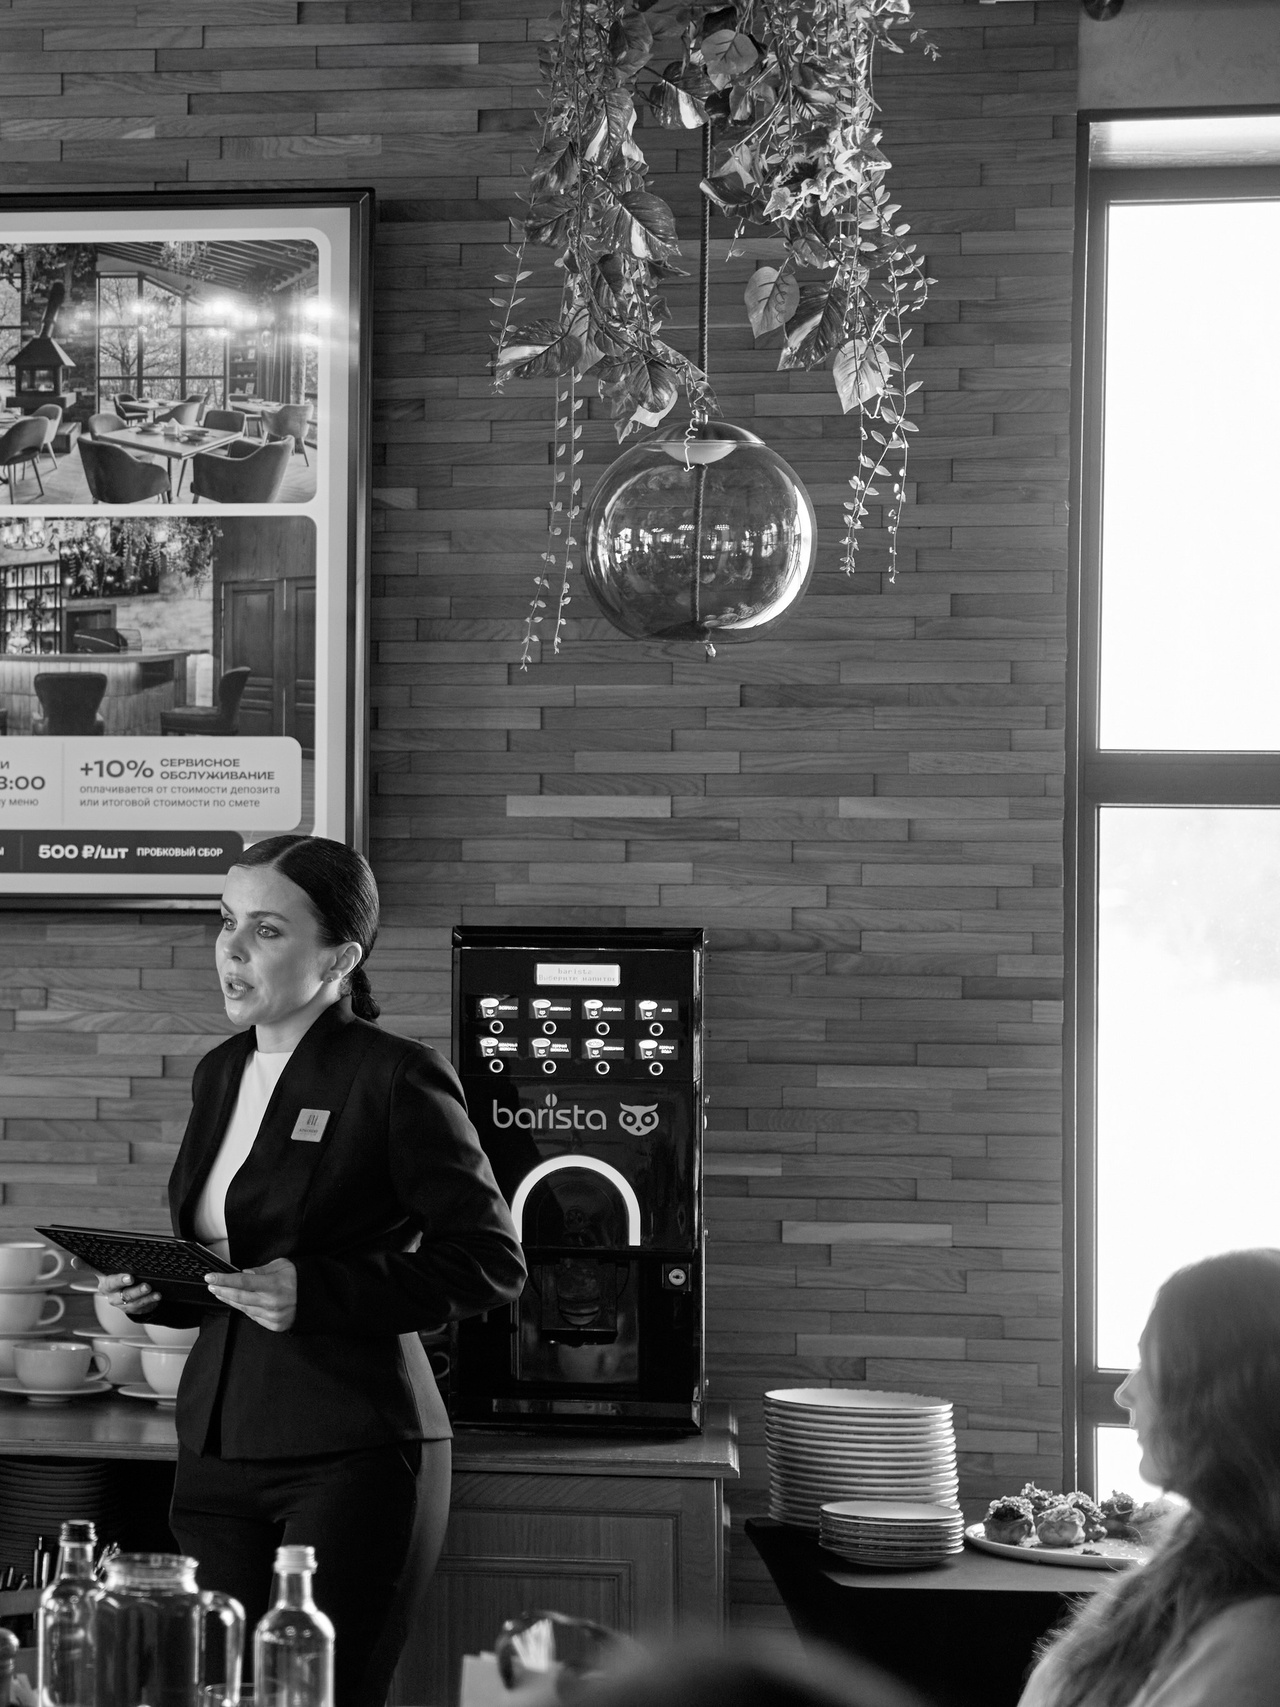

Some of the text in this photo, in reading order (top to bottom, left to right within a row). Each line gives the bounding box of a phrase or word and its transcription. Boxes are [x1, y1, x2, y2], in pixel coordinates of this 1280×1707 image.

[159, 757, 241, 768] СЕРВИСНОЕ
[79, 759, 155, 779] +10%
[159, 770, 275, 781] ОБСЛУЖИВАНИЕ
[79, 785, 281, 796] оплачивается от стоимости депозита
[8, 798, 40, 807] меню
[79, 797, 261, 808] или итоговой стоимости по смете
[38, 844, 79, 860] 500
[136, 845, 197, 858] ПРОБКОВЫЙ
[196, 847, 224, 858] СБОР
[492, 1093, 607, 1131] barista
